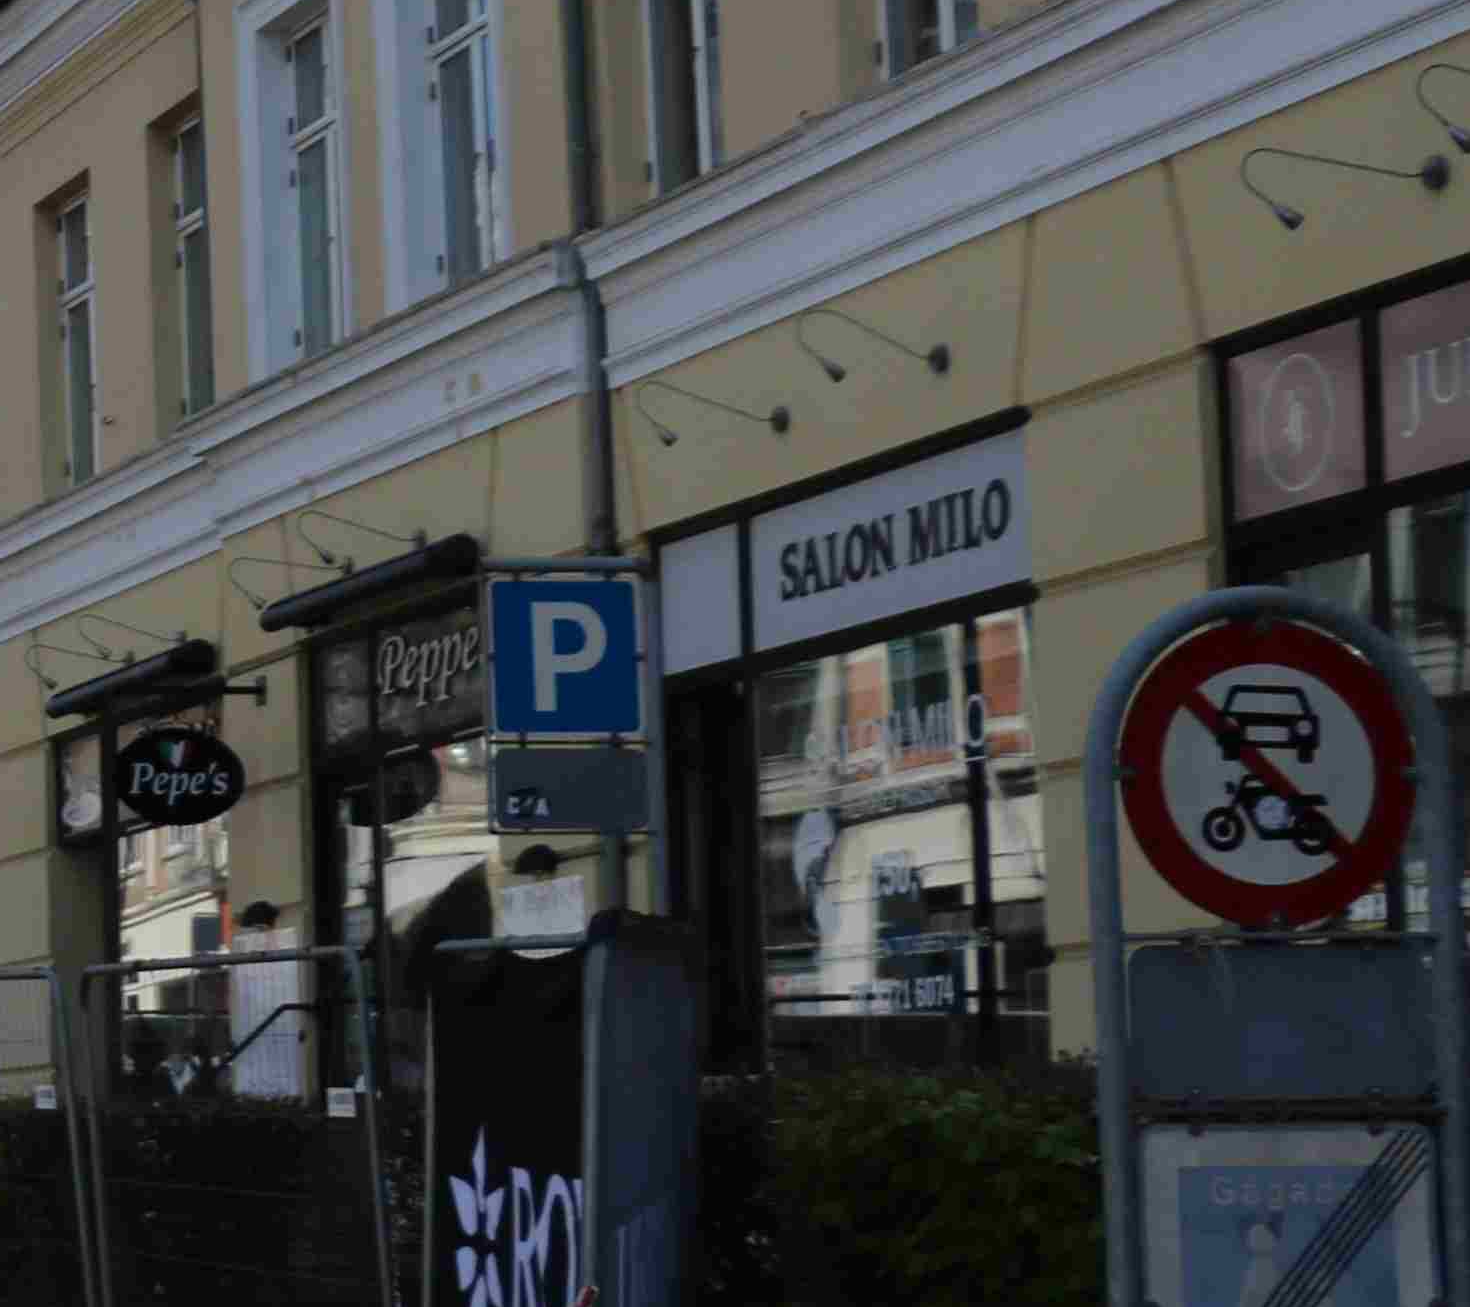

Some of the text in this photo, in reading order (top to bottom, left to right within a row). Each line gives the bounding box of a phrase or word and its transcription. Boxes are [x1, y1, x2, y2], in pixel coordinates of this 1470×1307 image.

[778, 477, 1012, 603] SALON MILO
[530, 600, 608, 713] P
[127, 759, 232, 807] Pepe's
